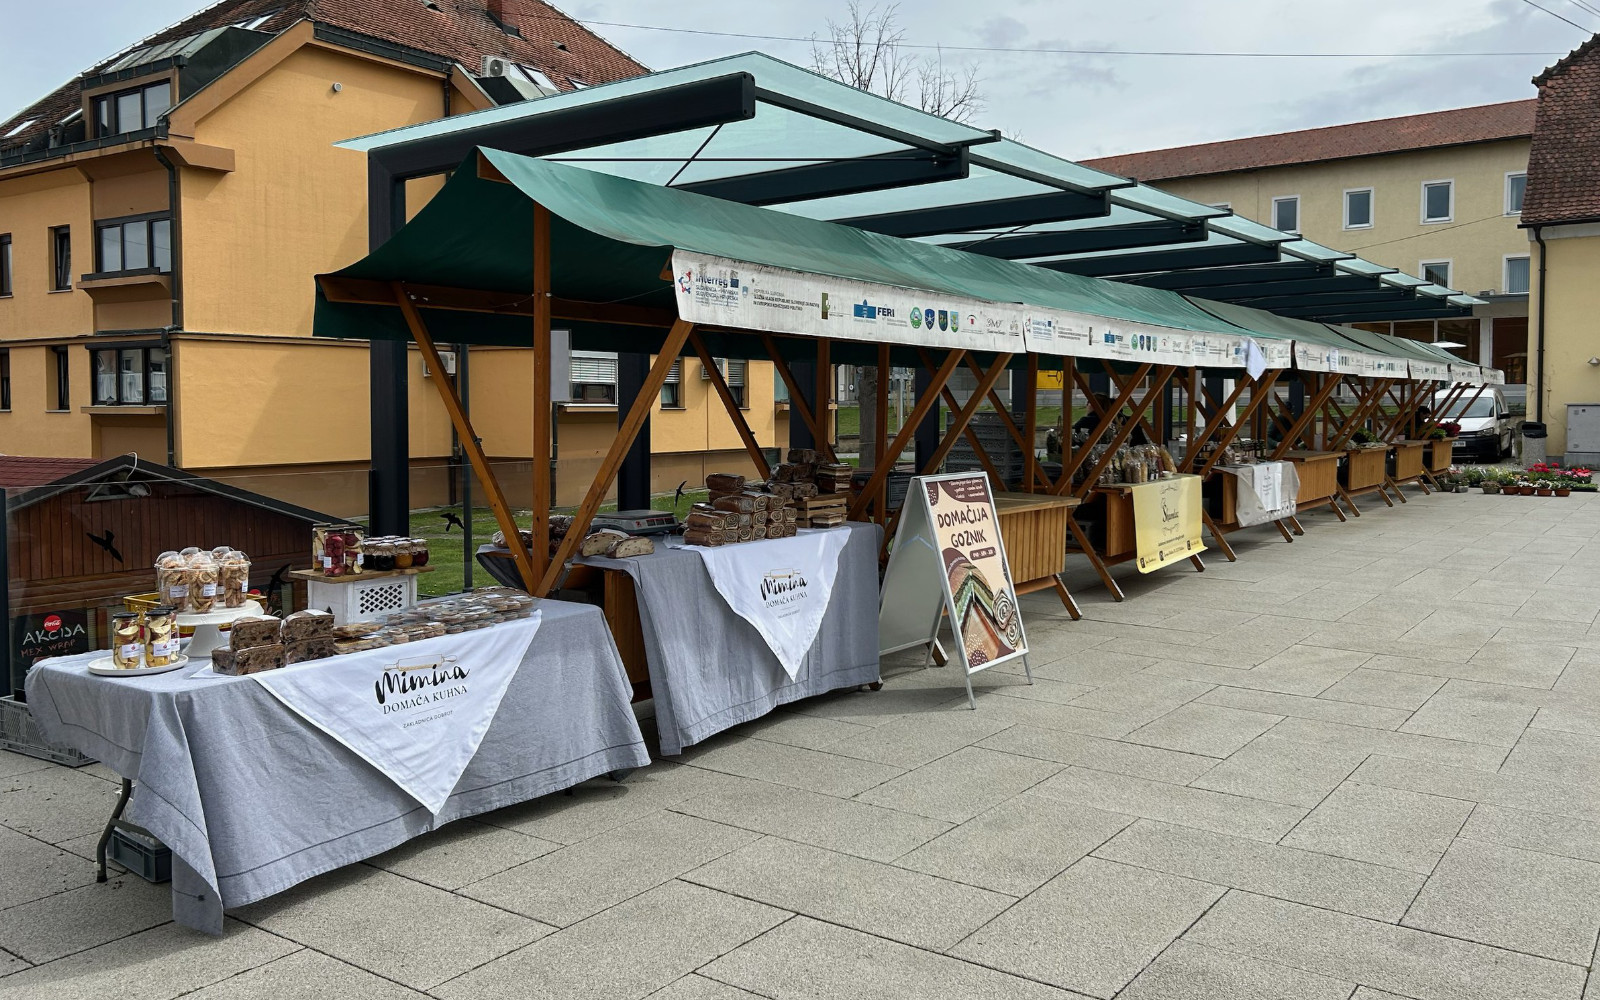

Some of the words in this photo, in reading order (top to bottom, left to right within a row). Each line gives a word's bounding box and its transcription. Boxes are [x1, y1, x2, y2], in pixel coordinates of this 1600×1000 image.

[877, 306, 895, 317] FERI
[937, 505, 989, 528] DOMAČIJA
[951, 529, 987, 548] GOZNIK
[760, 575, 809, 601] Mimina
[22, 624, 86, 646] AKCIJA
[20, 646, 43, 659] MEX
[48, 638, 76, 652] WRAP
[375, 664, 471, 704] Mimina
[383, 694, 430, 715] DOMAČA
[432, 685, 468, 702] KUHNA
[403, 716, 434, 729] ZAKLADNICA
